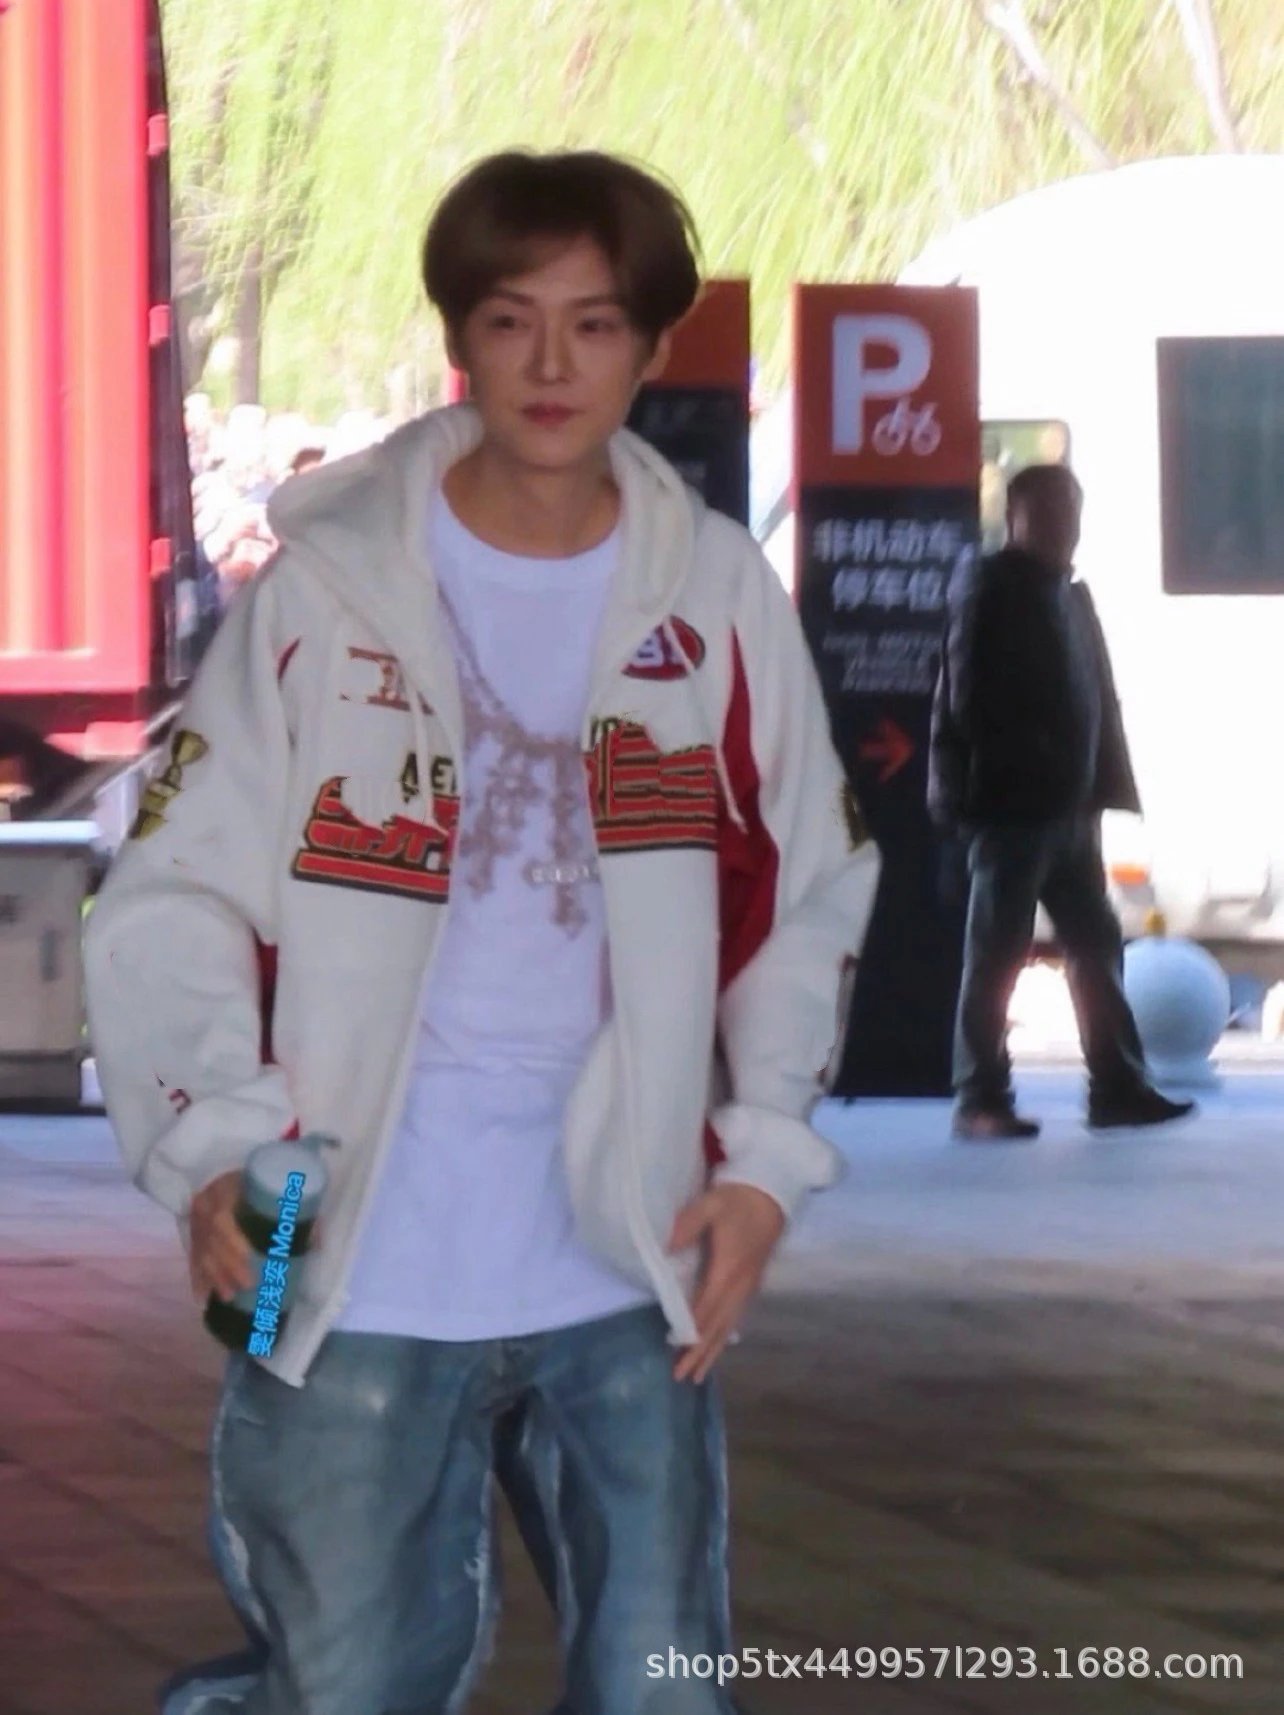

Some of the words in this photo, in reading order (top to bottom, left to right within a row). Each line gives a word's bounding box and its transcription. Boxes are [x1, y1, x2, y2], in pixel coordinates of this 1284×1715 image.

[832, 313, 932, 455] P
[813, 518, 962, 563] 非机动车
[832, 567, 944, 612] 停车位
